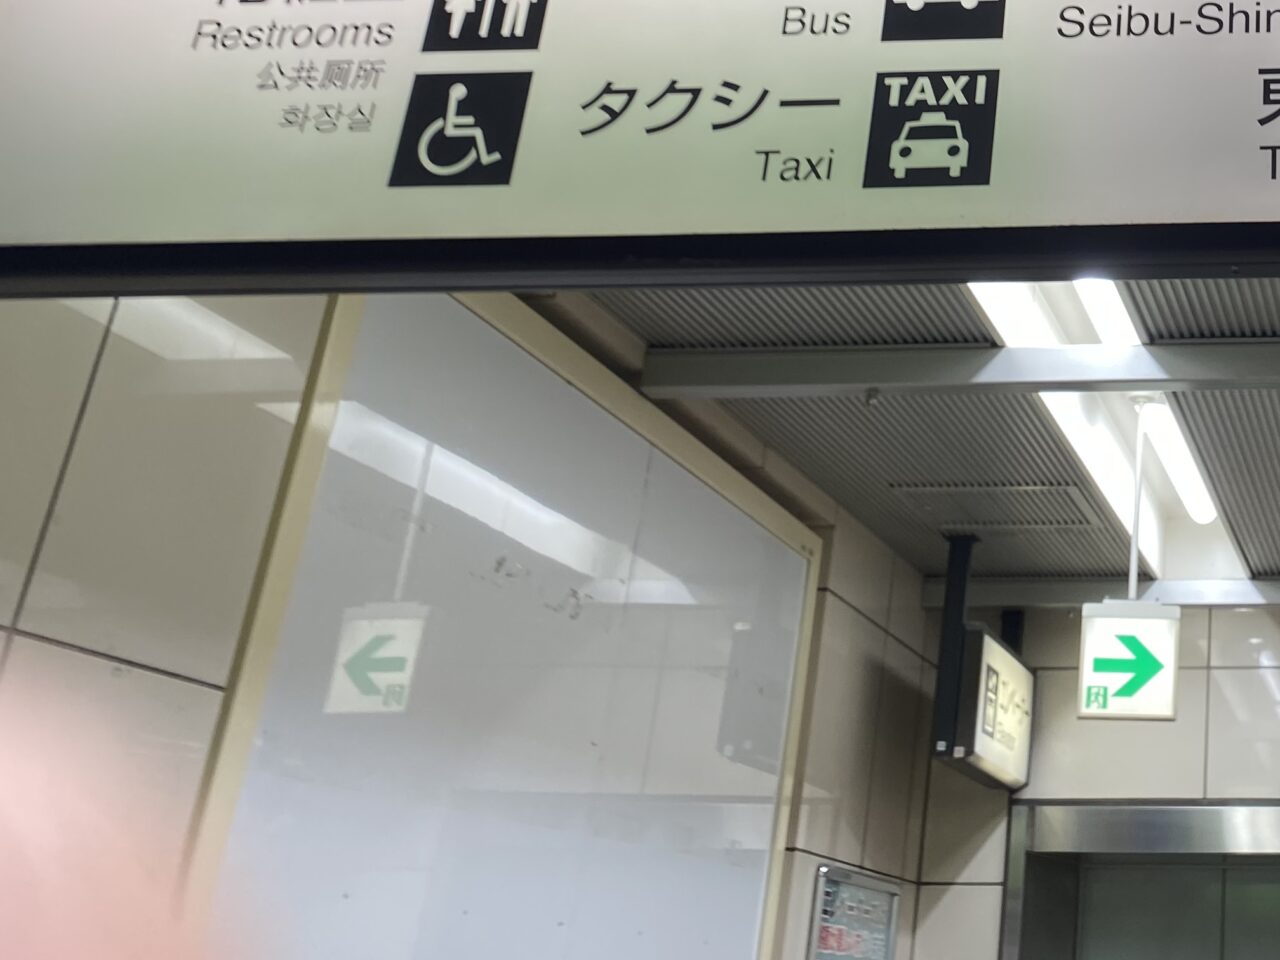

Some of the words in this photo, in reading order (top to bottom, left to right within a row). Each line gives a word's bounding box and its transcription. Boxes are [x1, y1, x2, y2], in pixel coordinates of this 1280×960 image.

[191, 20, 395, 50] Restrooms
[781, 6, 851, 37] Bus
[256, 59, 386, 91] 公共厕所
[884, 75, 987, 107] TAXI
[278, 102, 376, 134] 화장실
[579, 79, 841, 138] タクシー
[754, 148, 835, 183] Taxi
